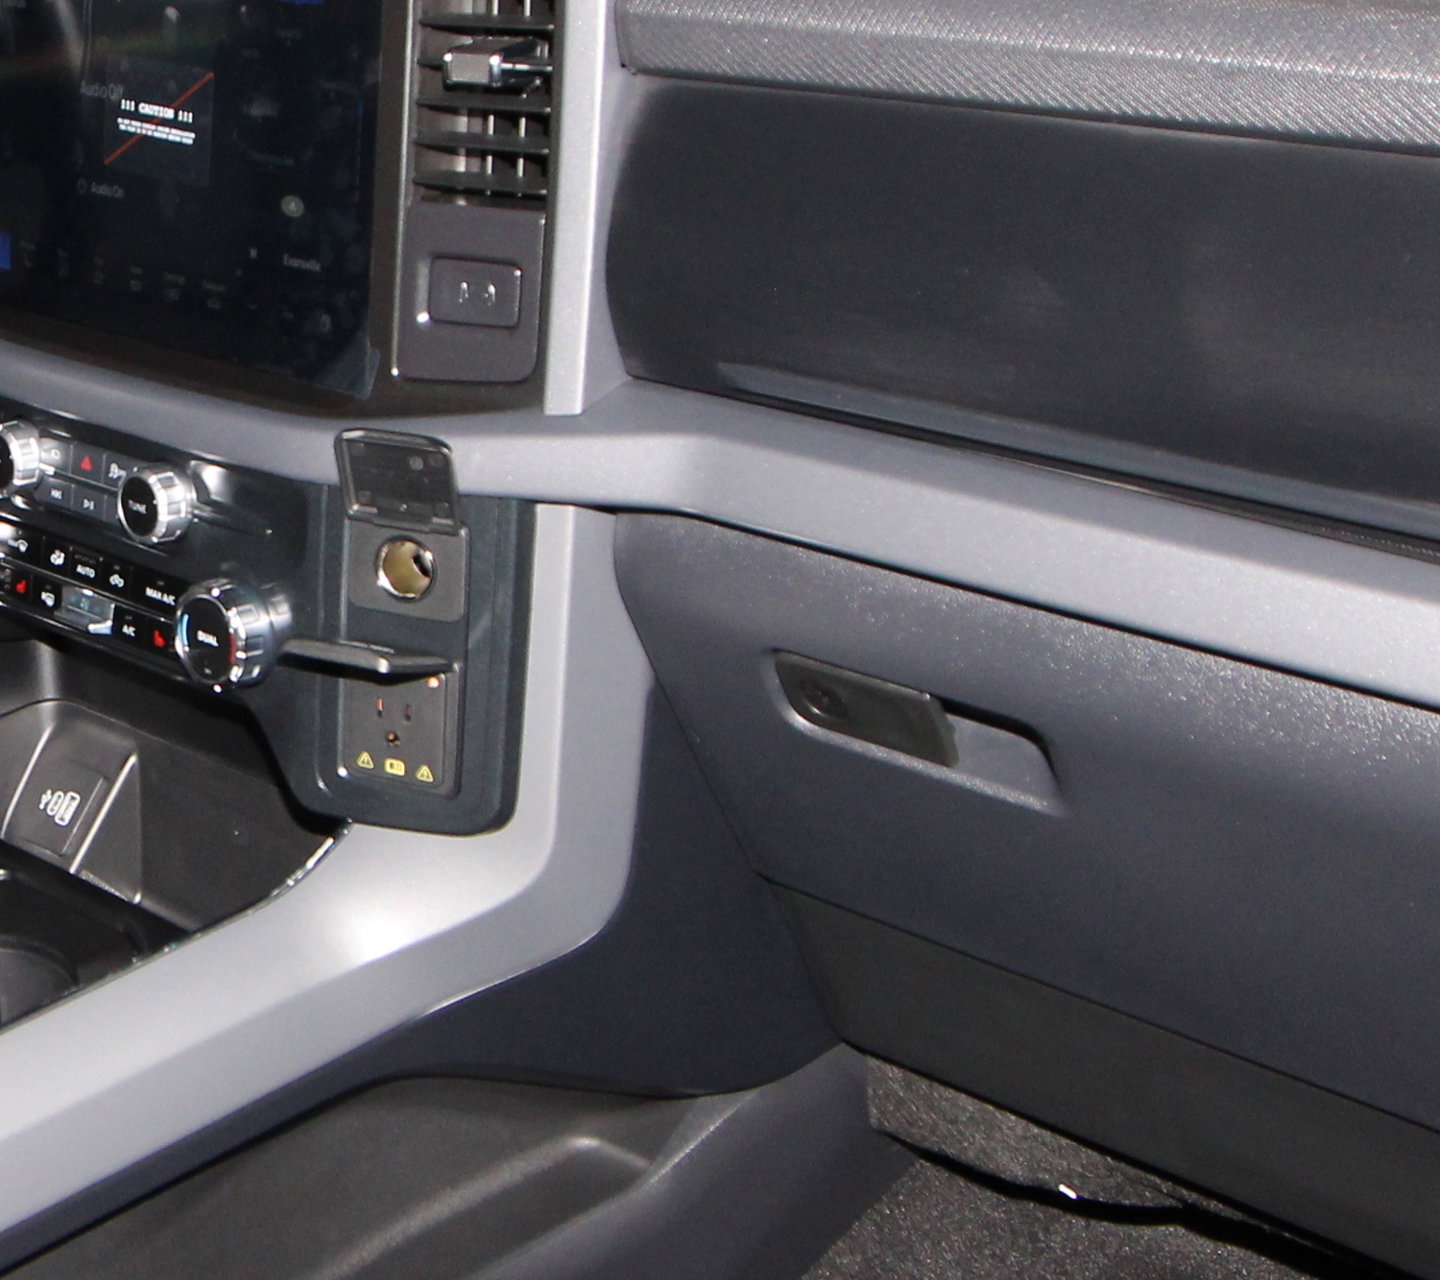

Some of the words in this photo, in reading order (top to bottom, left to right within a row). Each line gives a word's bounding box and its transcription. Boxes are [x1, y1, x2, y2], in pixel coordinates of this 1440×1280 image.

[138, 102, 176, 120] CAUTION
[76, 564, 95, 578] AUTO
[146, 587, 162, 600] MAX
[122, 623, 136, 638] A/C
[196, 629, 220, 648] DUAL
